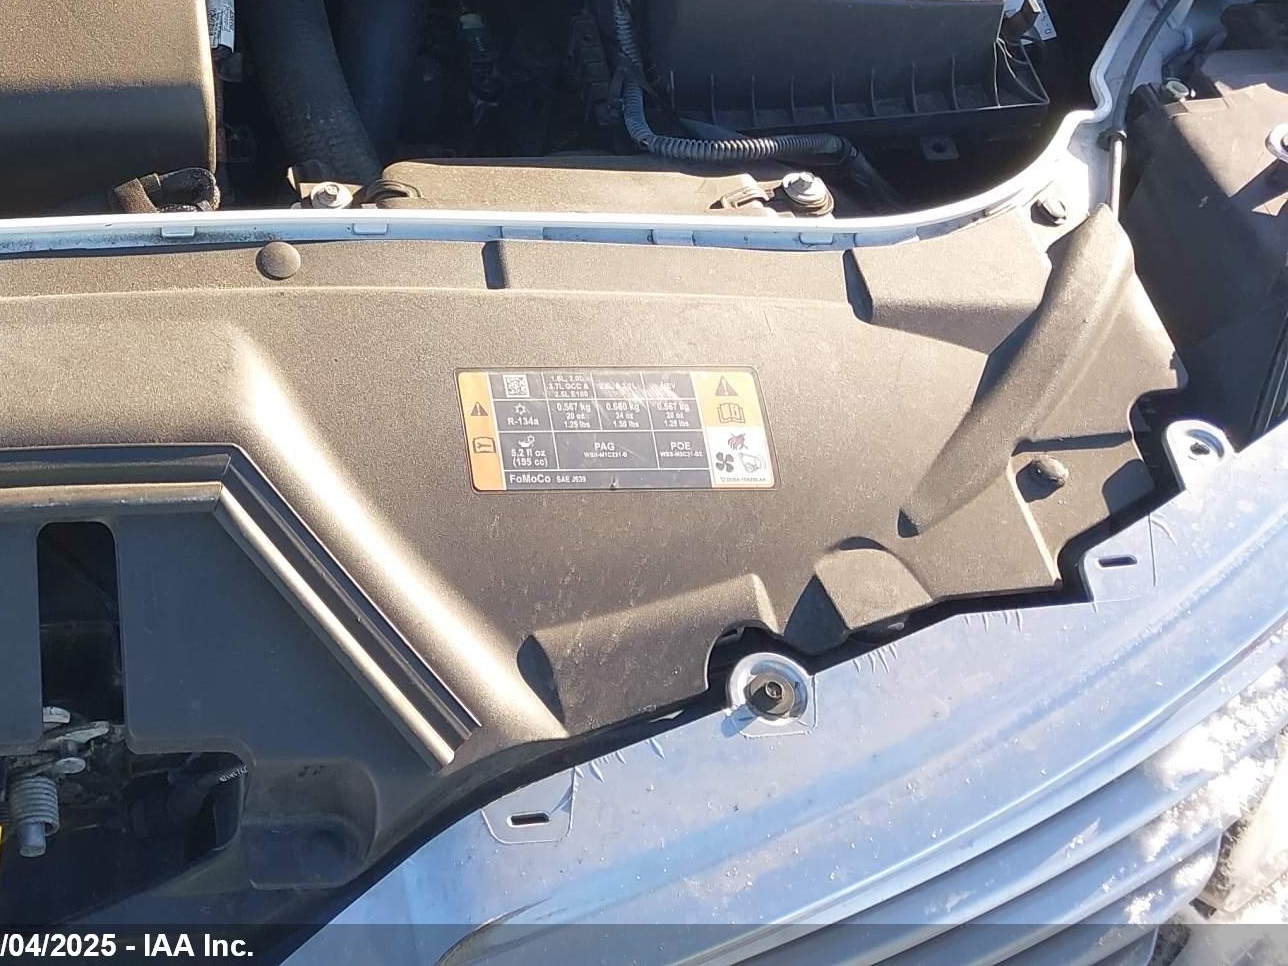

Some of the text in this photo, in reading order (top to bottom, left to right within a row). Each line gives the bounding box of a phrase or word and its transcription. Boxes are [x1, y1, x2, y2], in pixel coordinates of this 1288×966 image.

[556, 401, 591, 413] 0.567 kg
[629, 401, 640, 413] kg
[679, 401, 690, 413] kg
[566, 412, 575, 420] 20
[507, 416, 540, 426] R-134a
[579, 420, 591, 428] lbs
[628, 420, 640, 428] lbs
[594, 442, 615, 451] PAG
[670, 441, 692, 450] POE
[511, 448, 525, 457] 5.2
[526, 448, 533, 457] fl
[535, 457, 548, 467] cc)
[509, 474, 552, 484] FoMoCo
